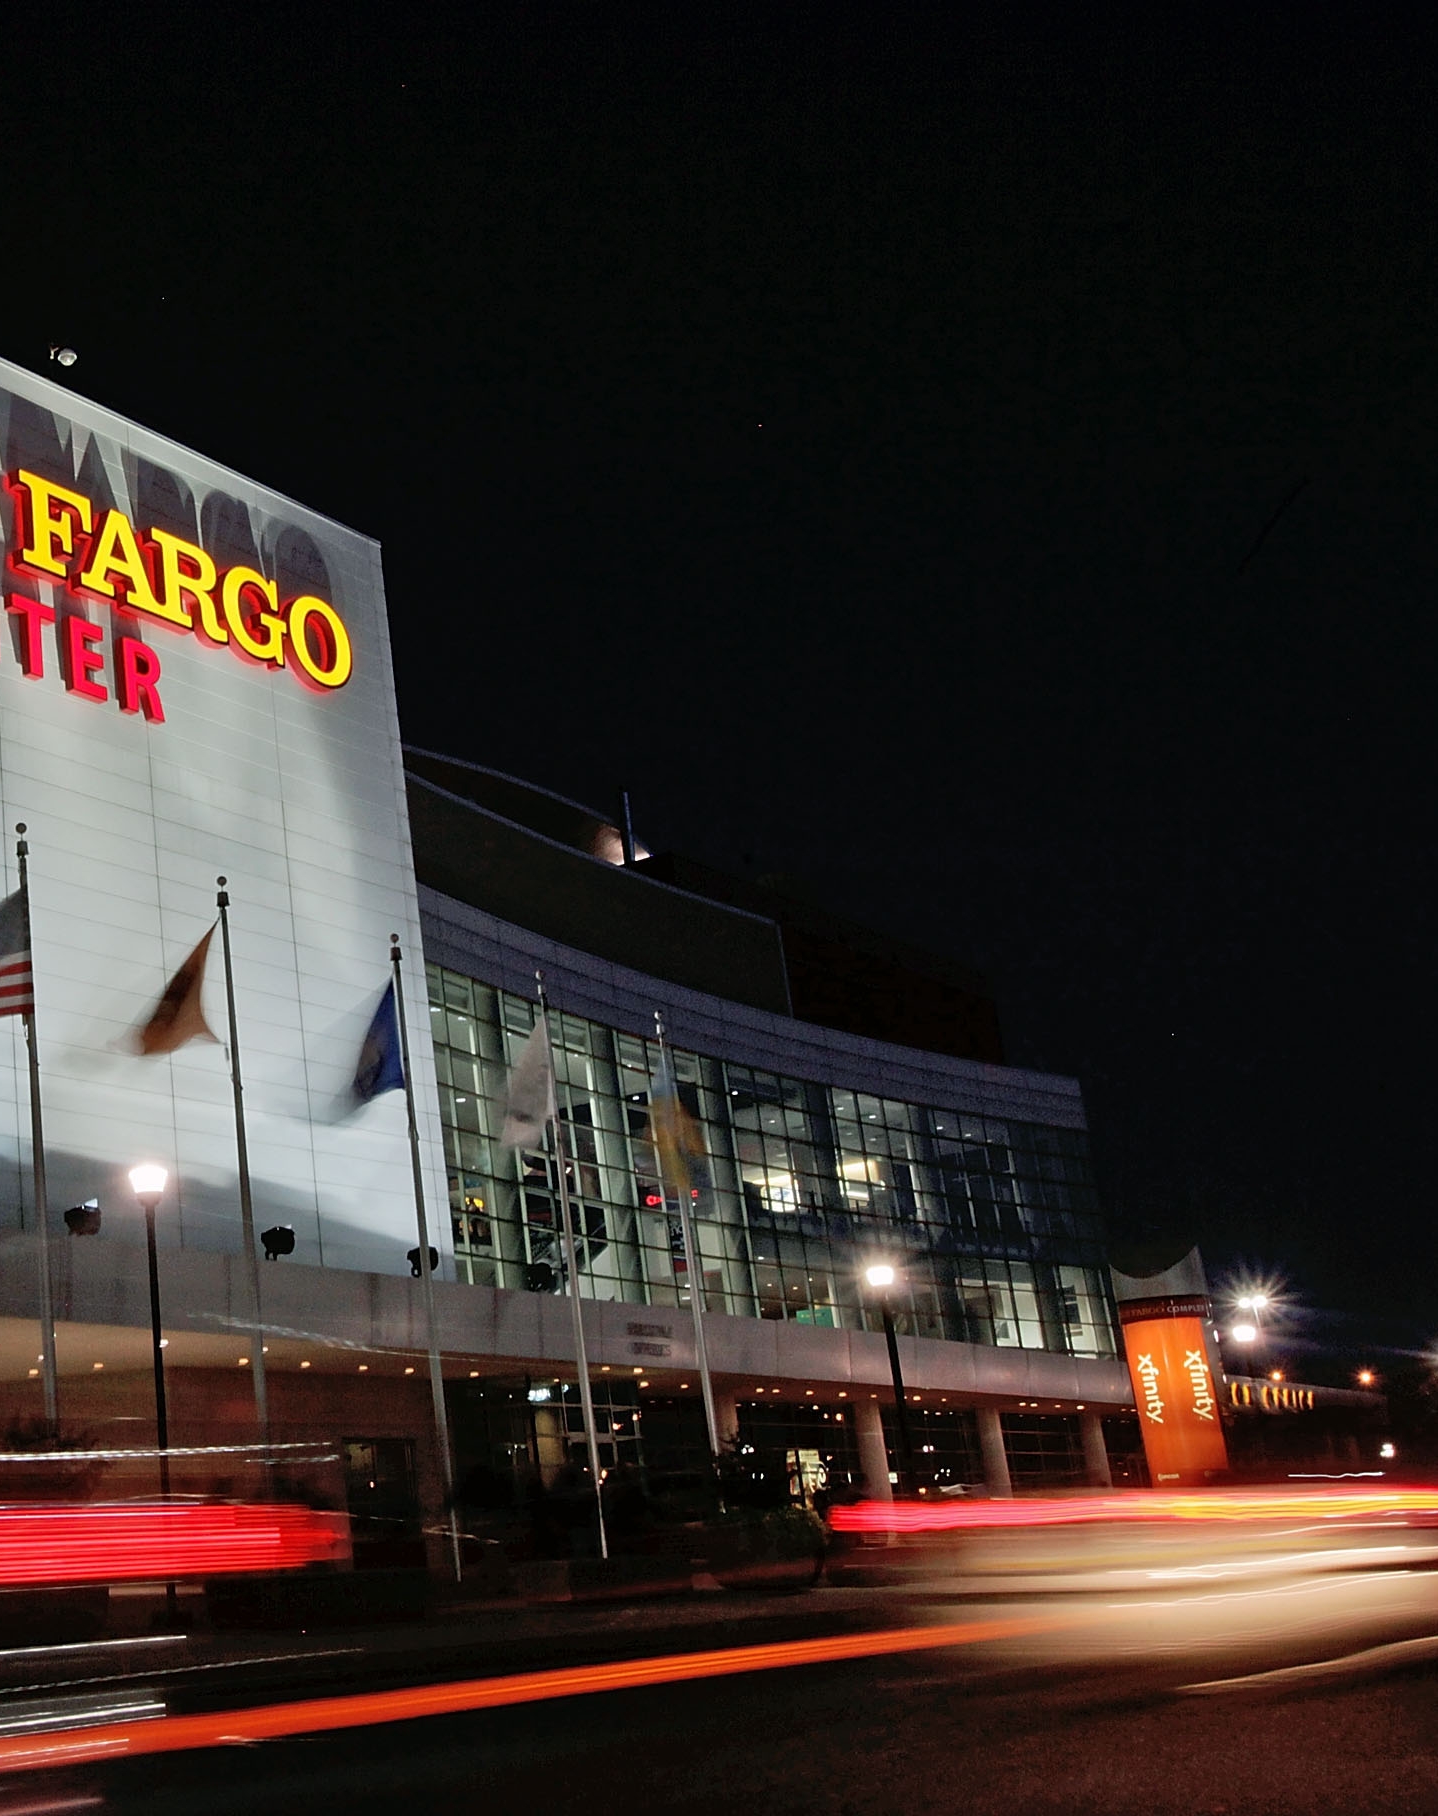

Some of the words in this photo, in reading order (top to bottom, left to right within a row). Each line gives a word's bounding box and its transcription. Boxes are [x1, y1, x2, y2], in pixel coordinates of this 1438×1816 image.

[15, 468, 354, 691] FARGO
[1167, 1304, 1205, 1313] COMPLE
[1137, 1353, 1165, 1424] xfinity
[1183, 1350, 1214, 1420] xfinity
